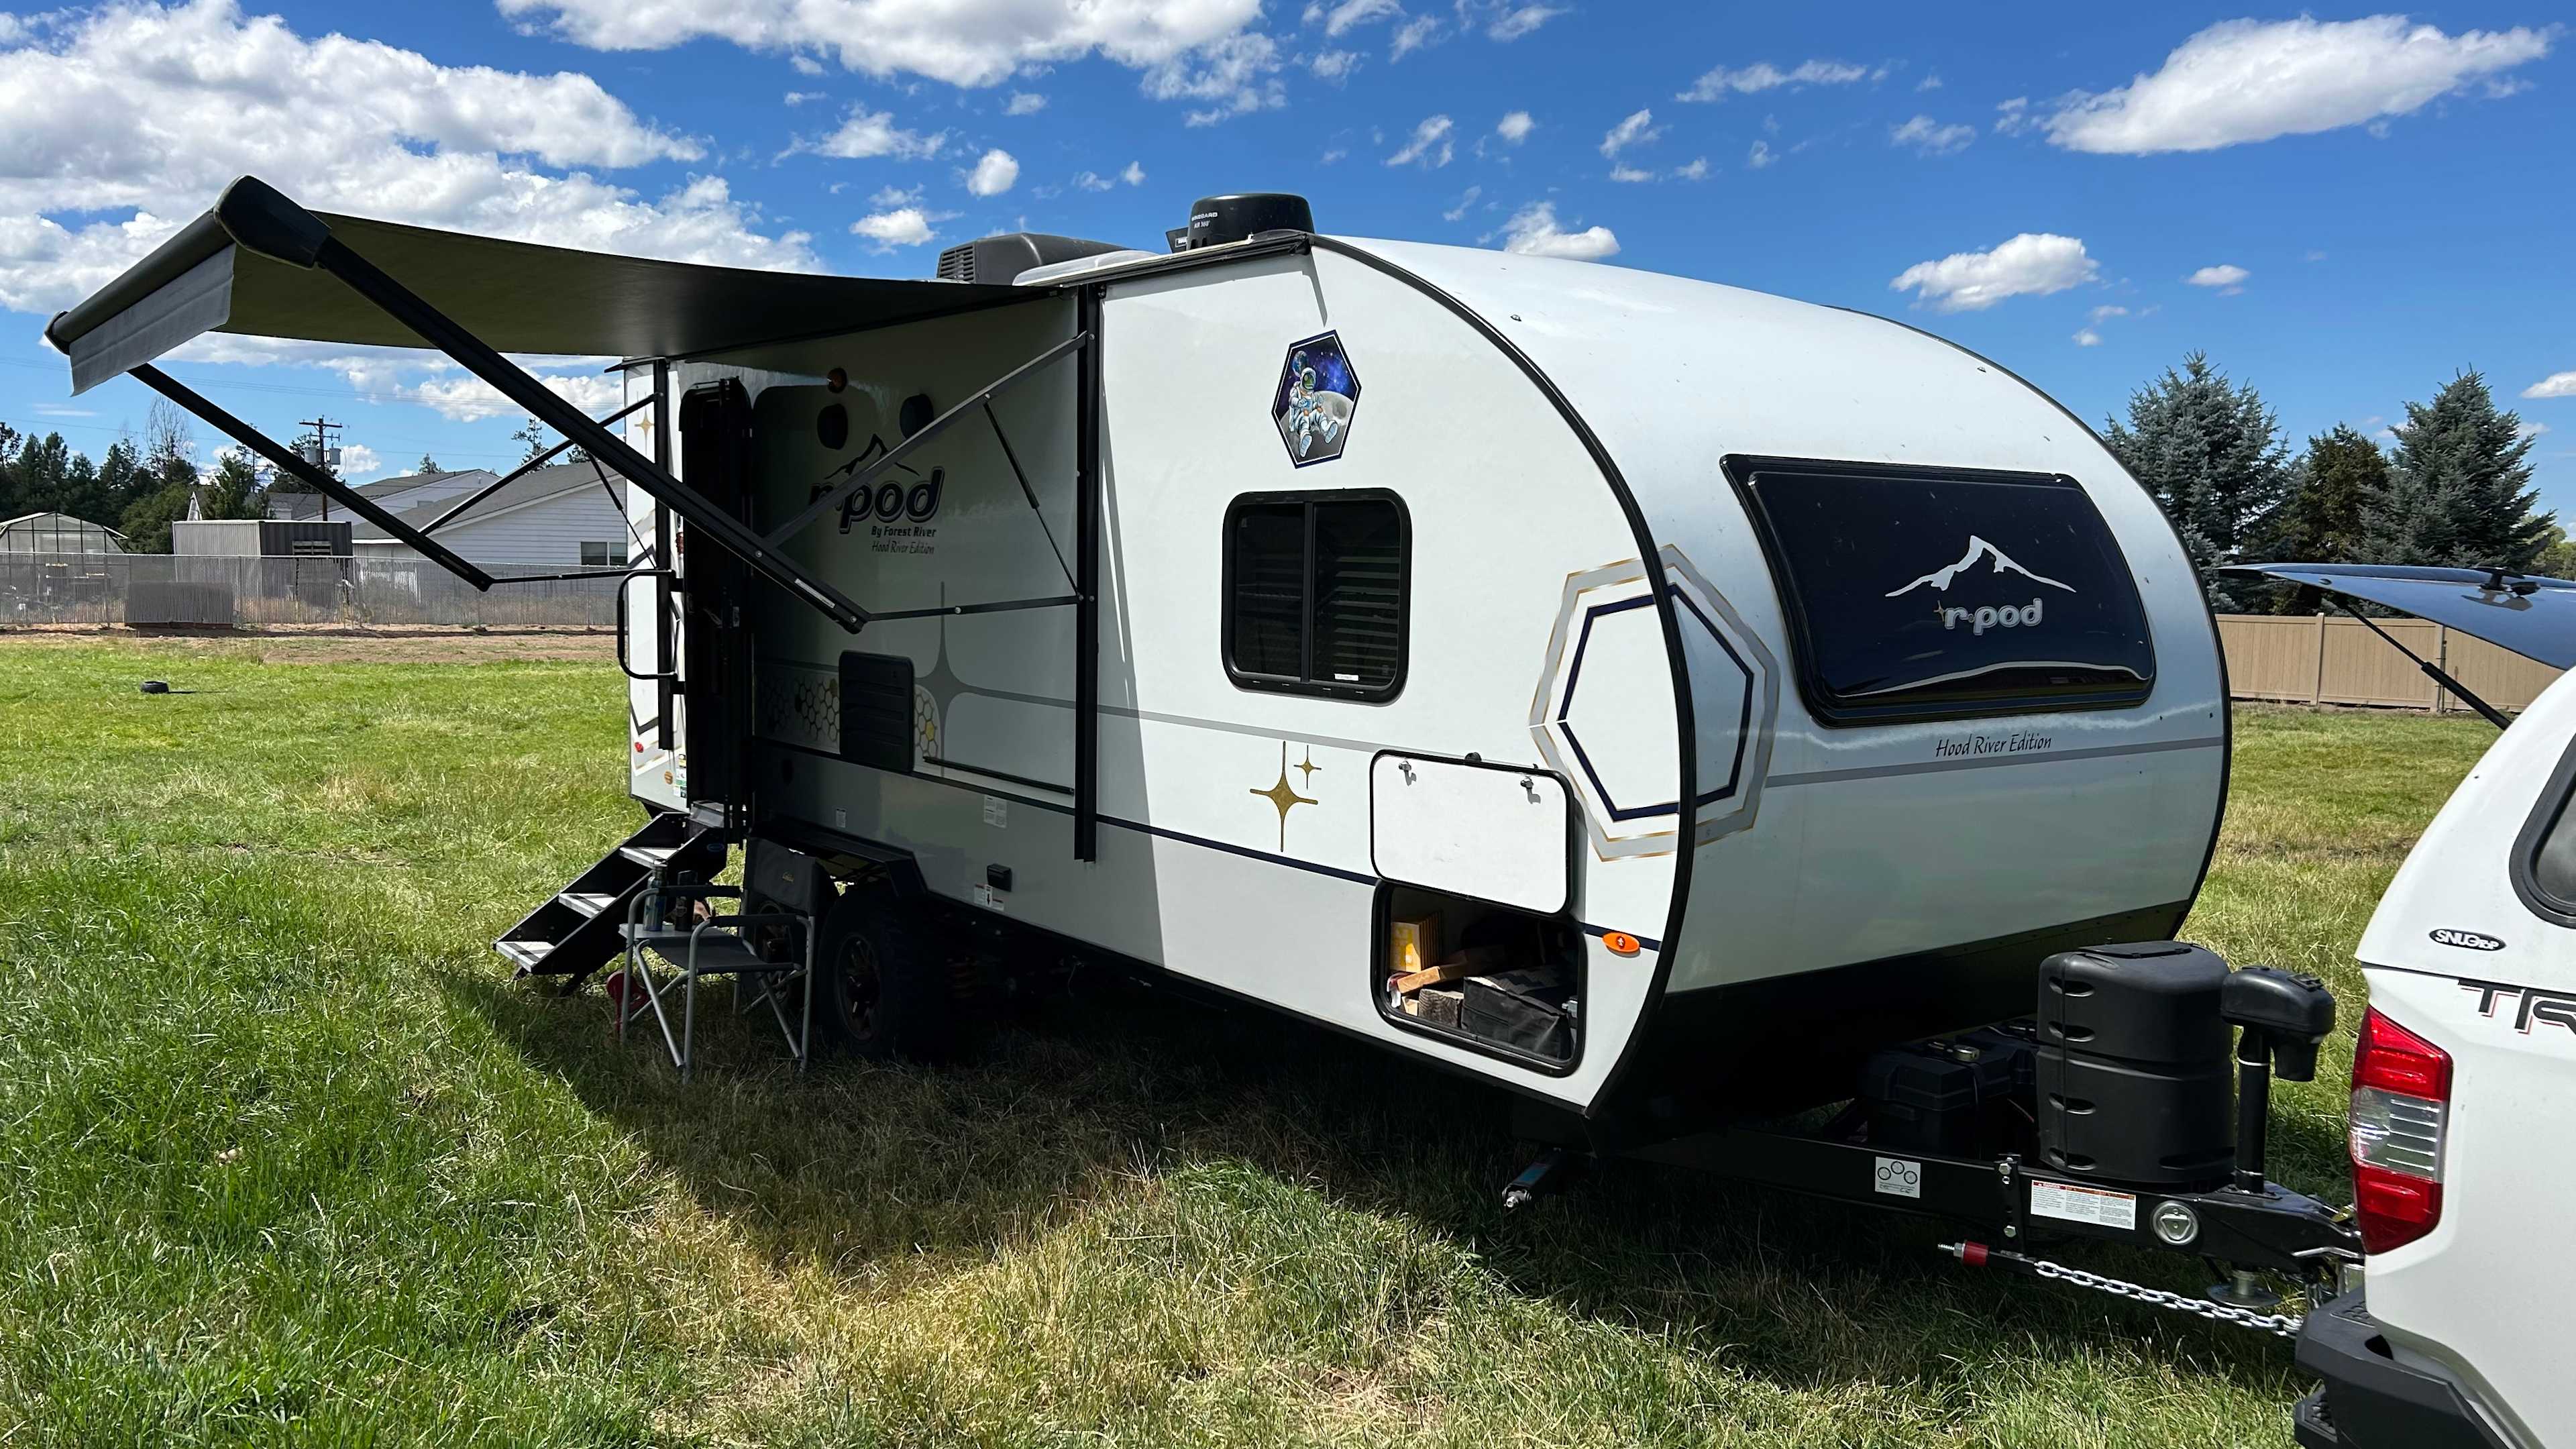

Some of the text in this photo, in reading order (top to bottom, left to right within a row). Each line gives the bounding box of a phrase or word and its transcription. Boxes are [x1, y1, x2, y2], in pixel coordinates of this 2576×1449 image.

[810, 467, 945, 534] rpod
[871, 526, 936, 537] By Forest River
[871, 539, 934, 554] Hood River Edition
[1936, 730, 2051, 757] Hood River Edition
